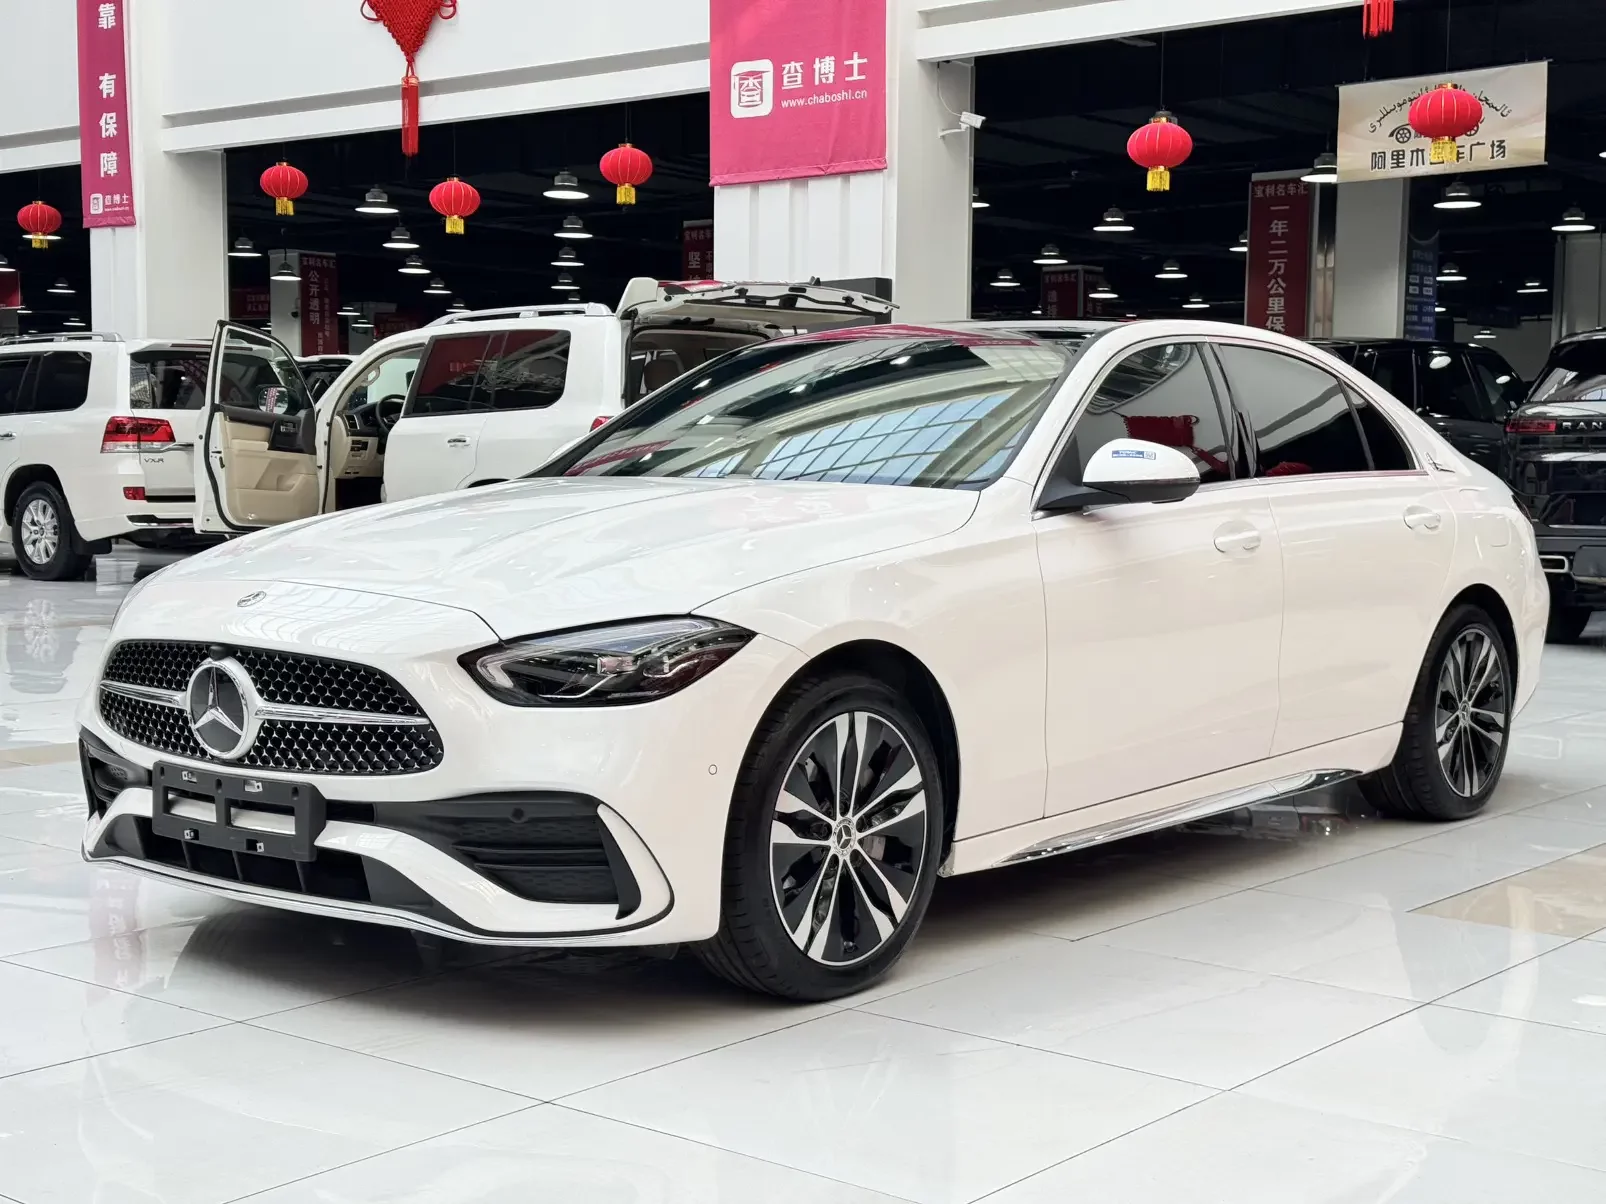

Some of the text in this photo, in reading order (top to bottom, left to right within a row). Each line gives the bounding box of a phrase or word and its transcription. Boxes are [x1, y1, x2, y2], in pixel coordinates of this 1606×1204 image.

[781, 51, 868, 90] 查博士
[98, 3, 119, 178] 靠 有保障
[780, 89, 867, 109] www.chaboshi.cn
[1370, 139, 1507, 171] 阿里木车广场
[1265, 203, 1290, 333] 一年二万公里保
[308, 270, 320, 325] 公开透明
[1562, 421, 1603, 429] RAN
